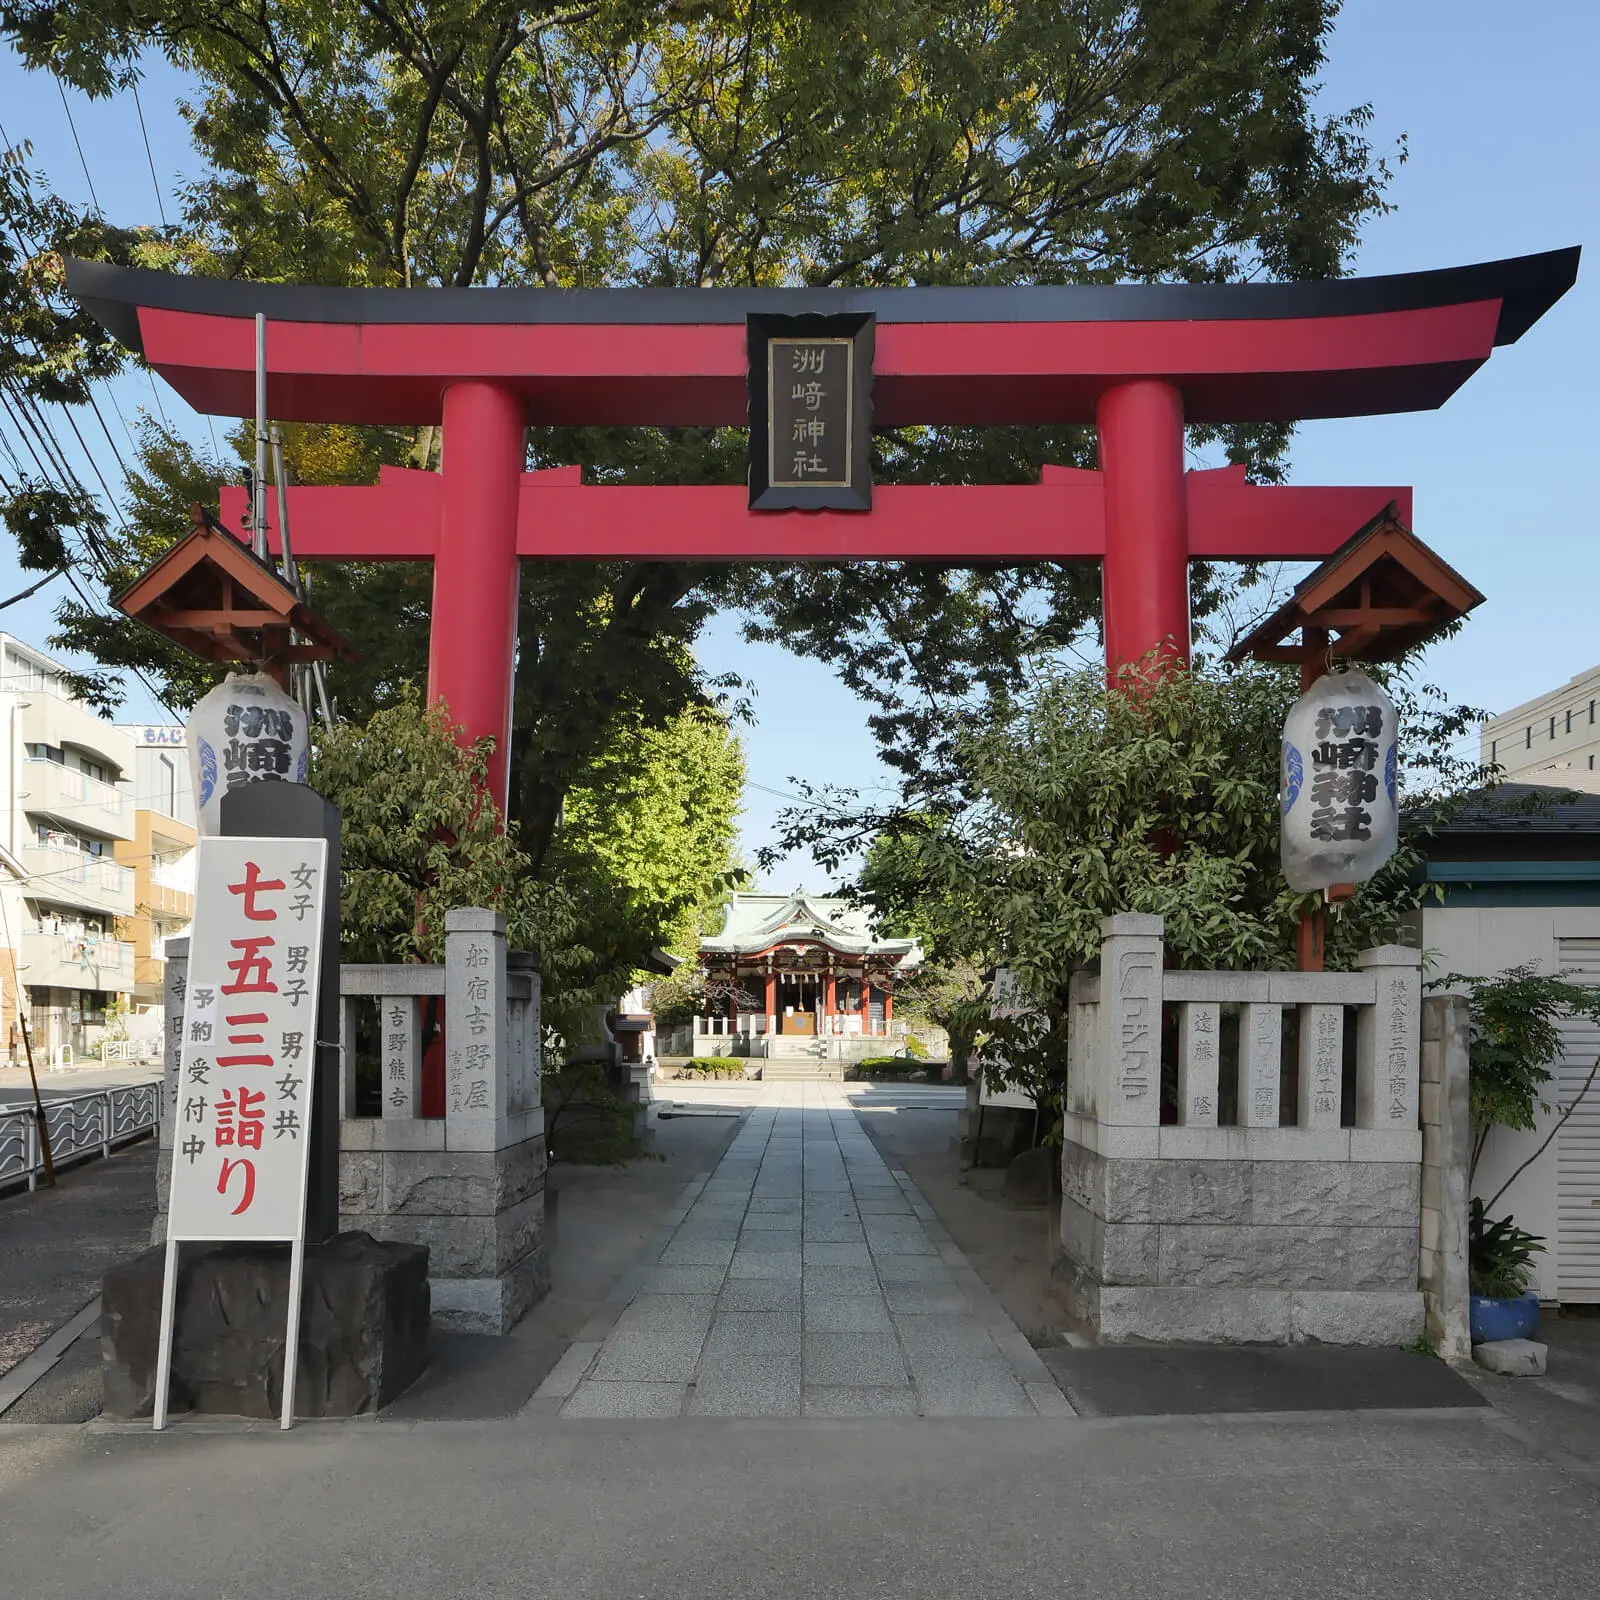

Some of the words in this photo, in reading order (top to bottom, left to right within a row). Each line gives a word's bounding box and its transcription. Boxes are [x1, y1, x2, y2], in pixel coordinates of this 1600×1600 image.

[288, 862, 317, 921] 女子
[282, 946, 310, 1007] 男子
[214, 861, 286, 1216] 七五三詣り
[388, 1004, 409, 1108] 吉野熊吉
